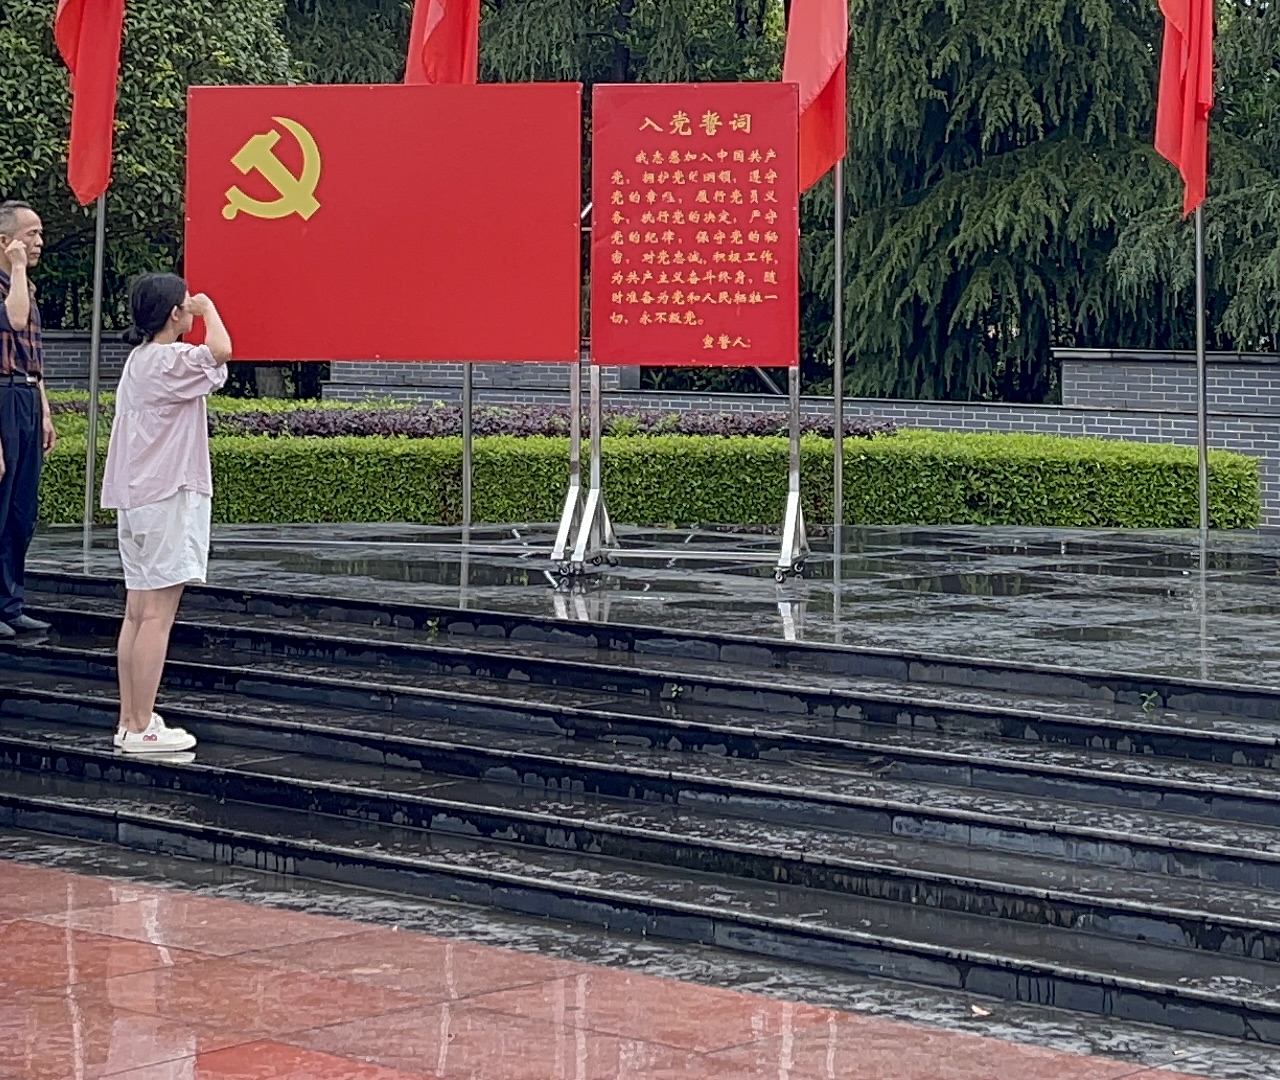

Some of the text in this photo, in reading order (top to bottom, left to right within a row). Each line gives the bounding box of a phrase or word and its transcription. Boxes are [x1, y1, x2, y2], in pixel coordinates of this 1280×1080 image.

[638, 109, 752, 136] 入党誓词
[635, 148, 777, 165] 我志愿加入中国共产
[611, 289, 779, 306] 时准备为党和人民牺牲一
